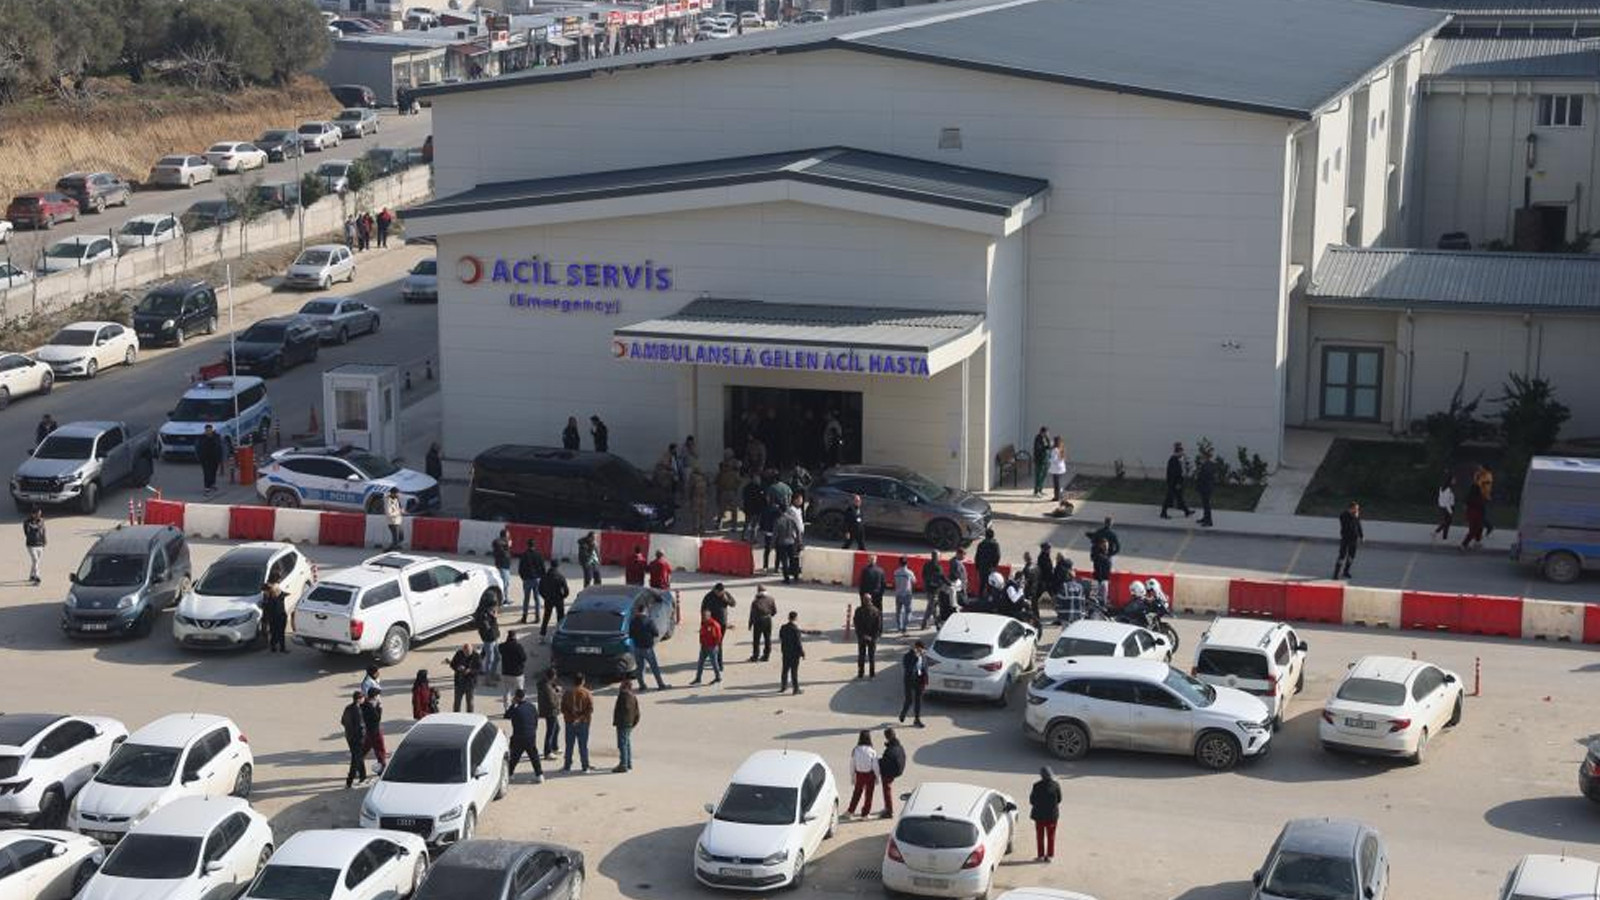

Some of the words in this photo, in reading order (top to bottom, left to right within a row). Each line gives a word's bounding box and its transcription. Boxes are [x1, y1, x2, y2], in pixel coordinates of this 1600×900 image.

[491, 255, 559, 285] ACİL
[566, 259, 673, 291] SERVİS
[630, 342, 754, 366] AMBULANSLA
[759, 349, 818, 369] GELEN
[823, 346, 864, 372] ACİL
[869, 354, 930, 376] HASTA
